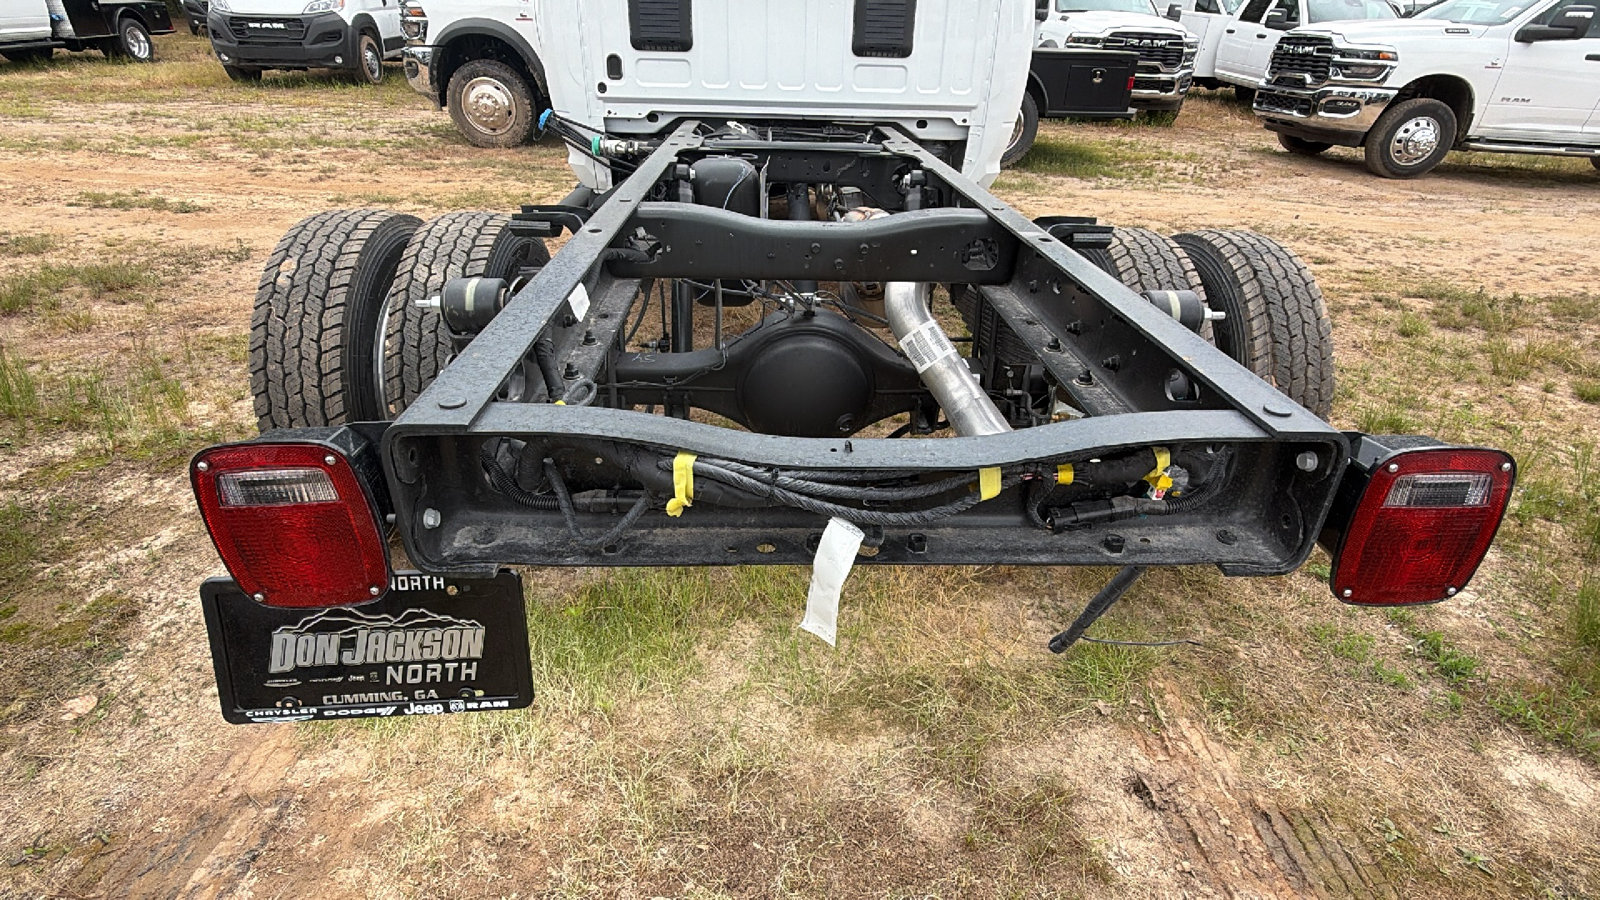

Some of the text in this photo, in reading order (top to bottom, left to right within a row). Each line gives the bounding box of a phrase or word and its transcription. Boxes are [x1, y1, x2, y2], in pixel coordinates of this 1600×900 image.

[1126, 38, 1167, 47] RAM
[268, 627, 485, 673] DON JACKSON
[386, 662, 478, 686] NORTH
[322, 689, 439, 705] CUMMING, GA
[245, 700, 509, 717] CHRYSLER DODGE Jeep RAM
